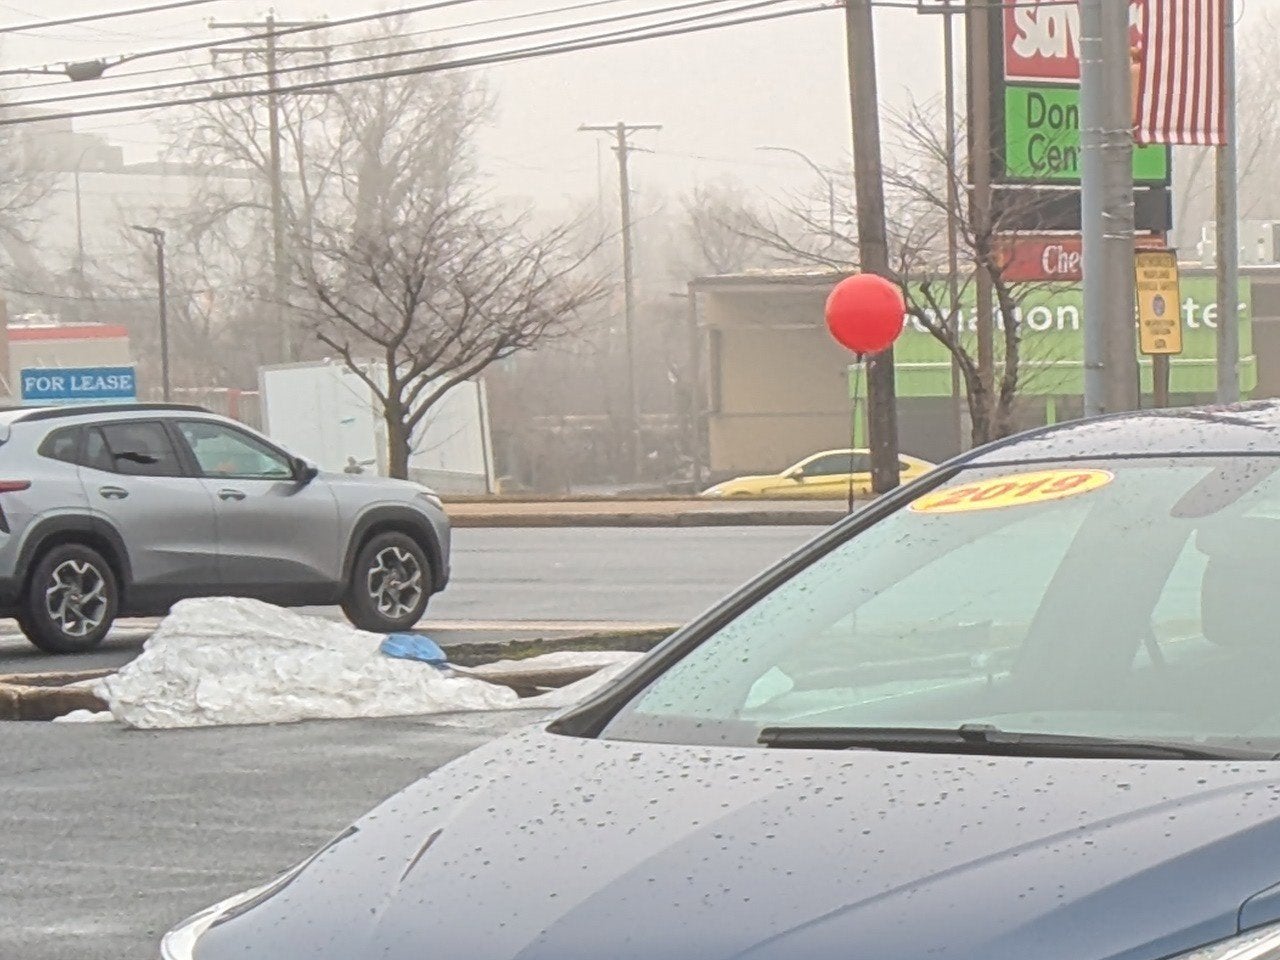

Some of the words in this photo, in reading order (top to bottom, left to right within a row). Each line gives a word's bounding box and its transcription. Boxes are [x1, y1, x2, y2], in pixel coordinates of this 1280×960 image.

[1027, 92, 1079, 130] Don
[1027, 133, 1080, 171] Cen
[25, 376, 65, 392] FOR
[70, 374, 132, 391] LEASE
[924, 473, 1091, 510] 2019
